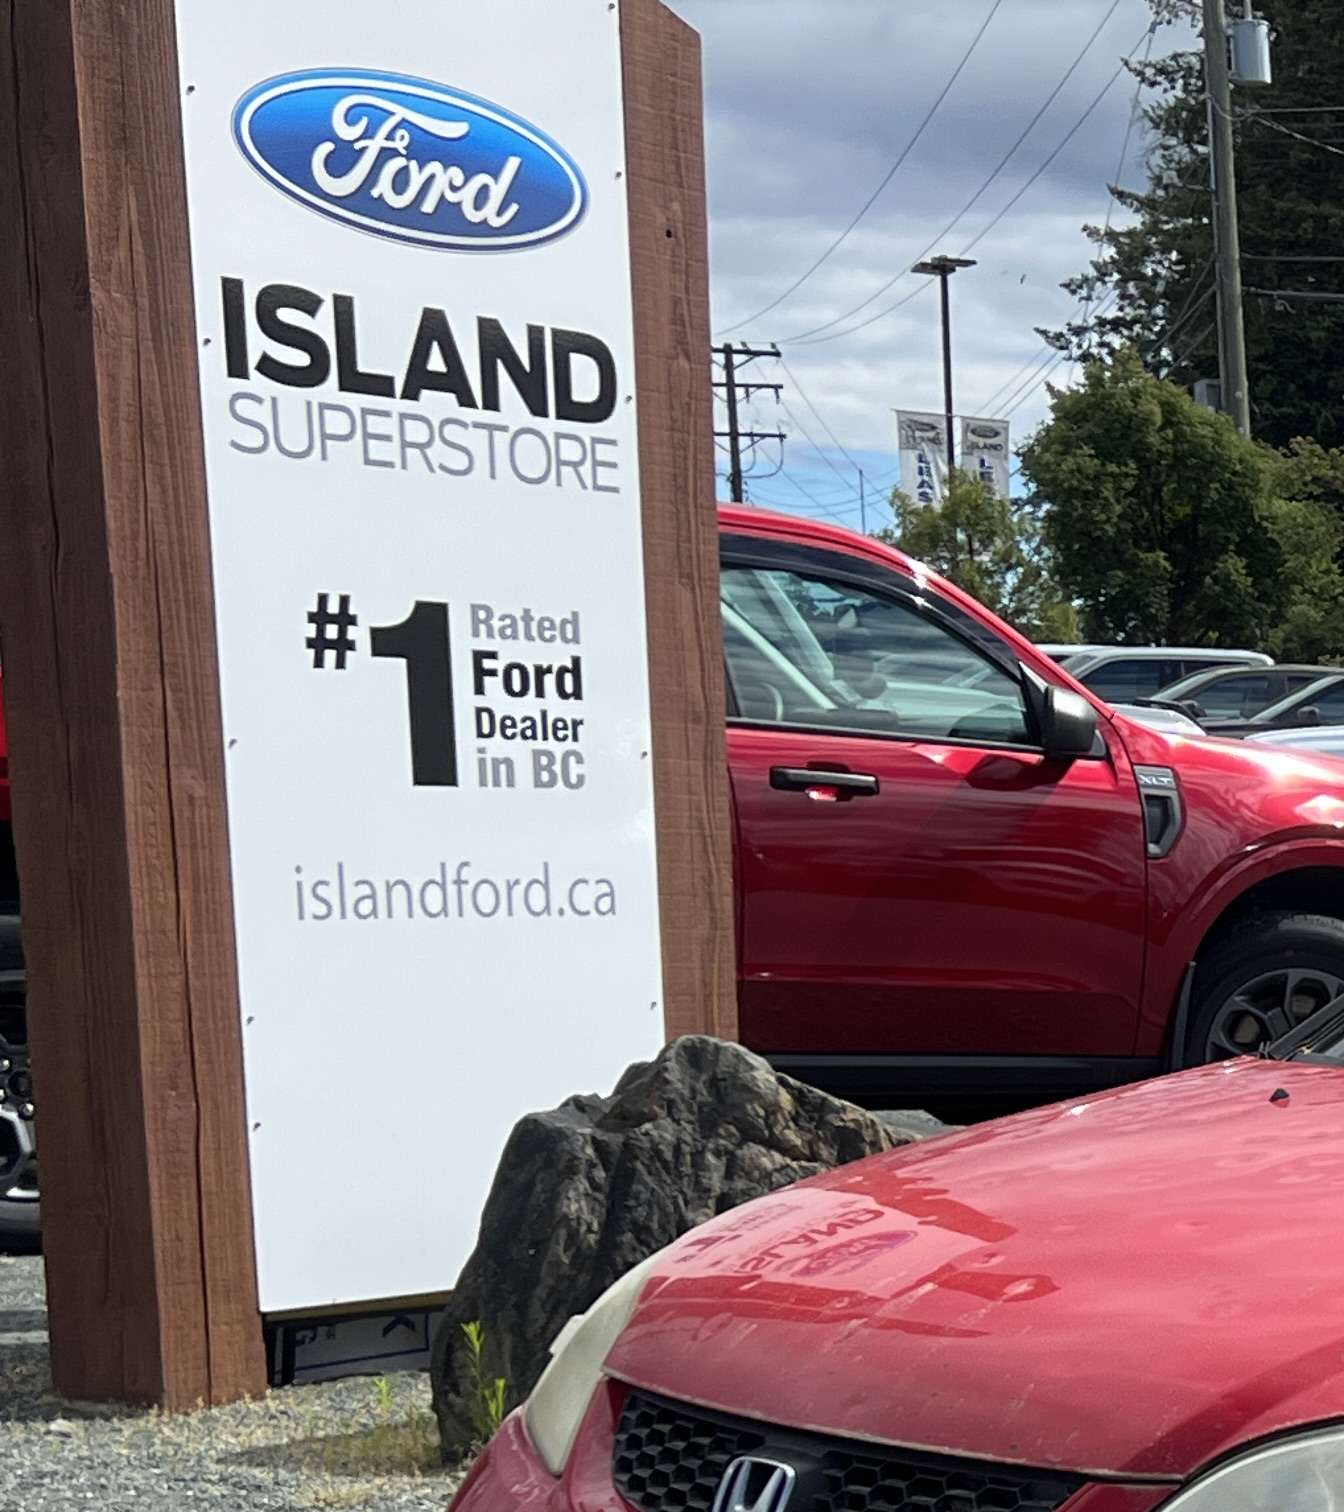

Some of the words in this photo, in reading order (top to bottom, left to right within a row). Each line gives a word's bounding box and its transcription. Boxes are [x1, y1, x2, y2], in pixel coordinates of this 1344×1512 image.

[311, 94, 522, 228] Ford
[220, 276, 618, 424] ISLAND
[228, 391, 621, 494] SUPERSTORE
[470, 603, 581, 645] Rated
[472, 649, 584, 701] Ford
[475, 706, 584, 743] Dealer
[477, 747, 516, 788] in
[532, 748, 586, 790] BC
[294, 861, 617, 921] islandford.ca
